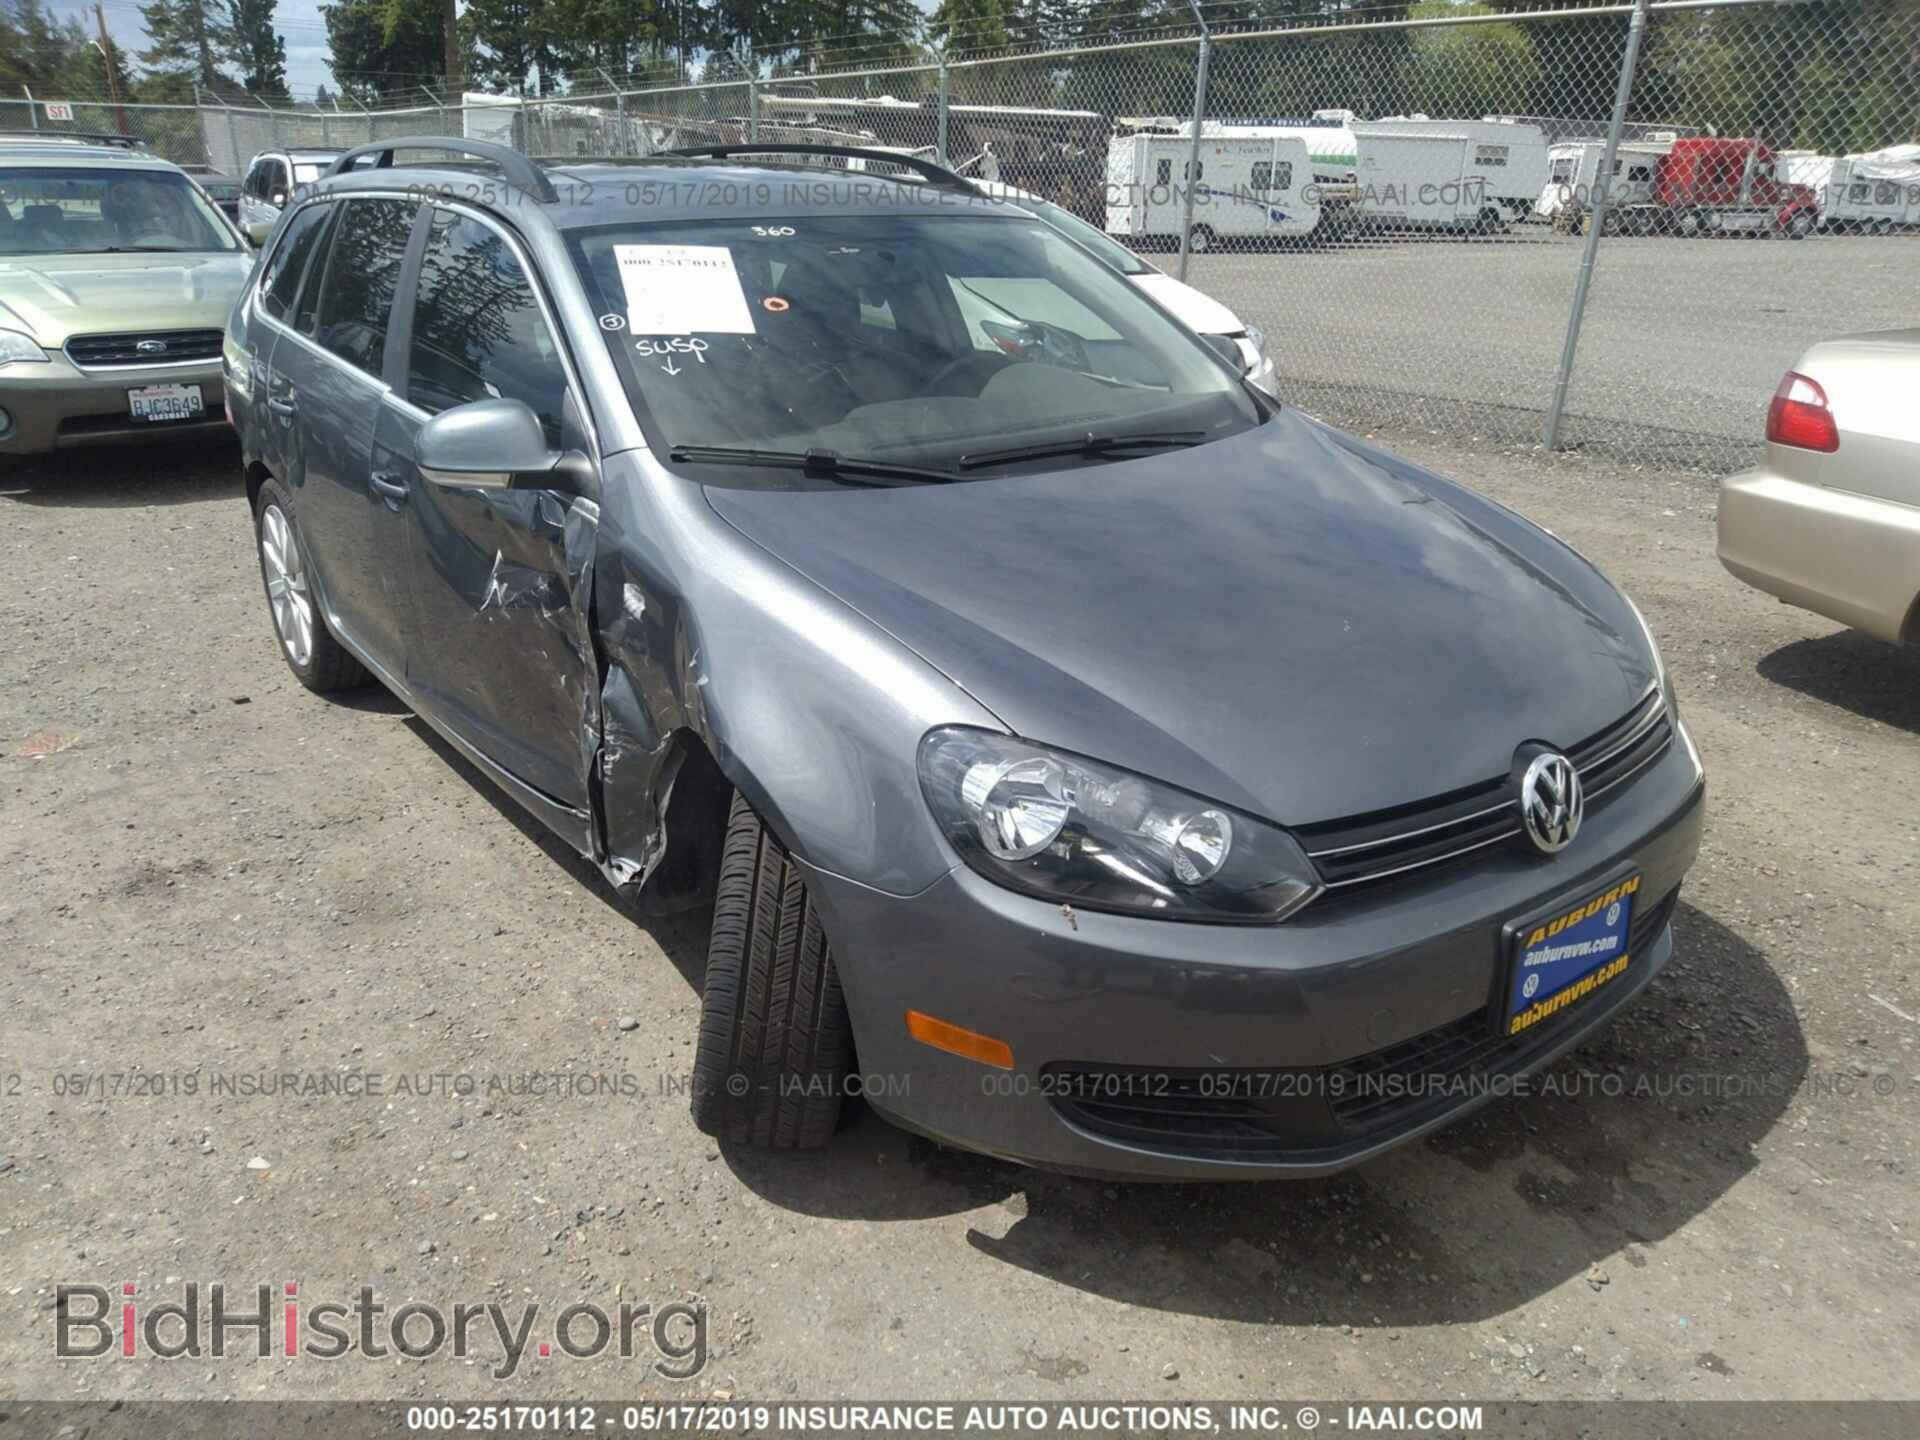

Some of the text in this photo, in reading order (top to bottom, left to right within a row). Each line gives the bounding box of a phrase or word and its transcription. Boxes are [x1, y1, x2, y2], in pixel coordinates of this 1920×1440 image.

[752, 226, 796, 236] 360
[1526, 876, 1640, 949] AUBURN
[1524, 935, 1618, 967] auburnvw.com
[1510, 954, 1629, 1035] auburnvw.com
